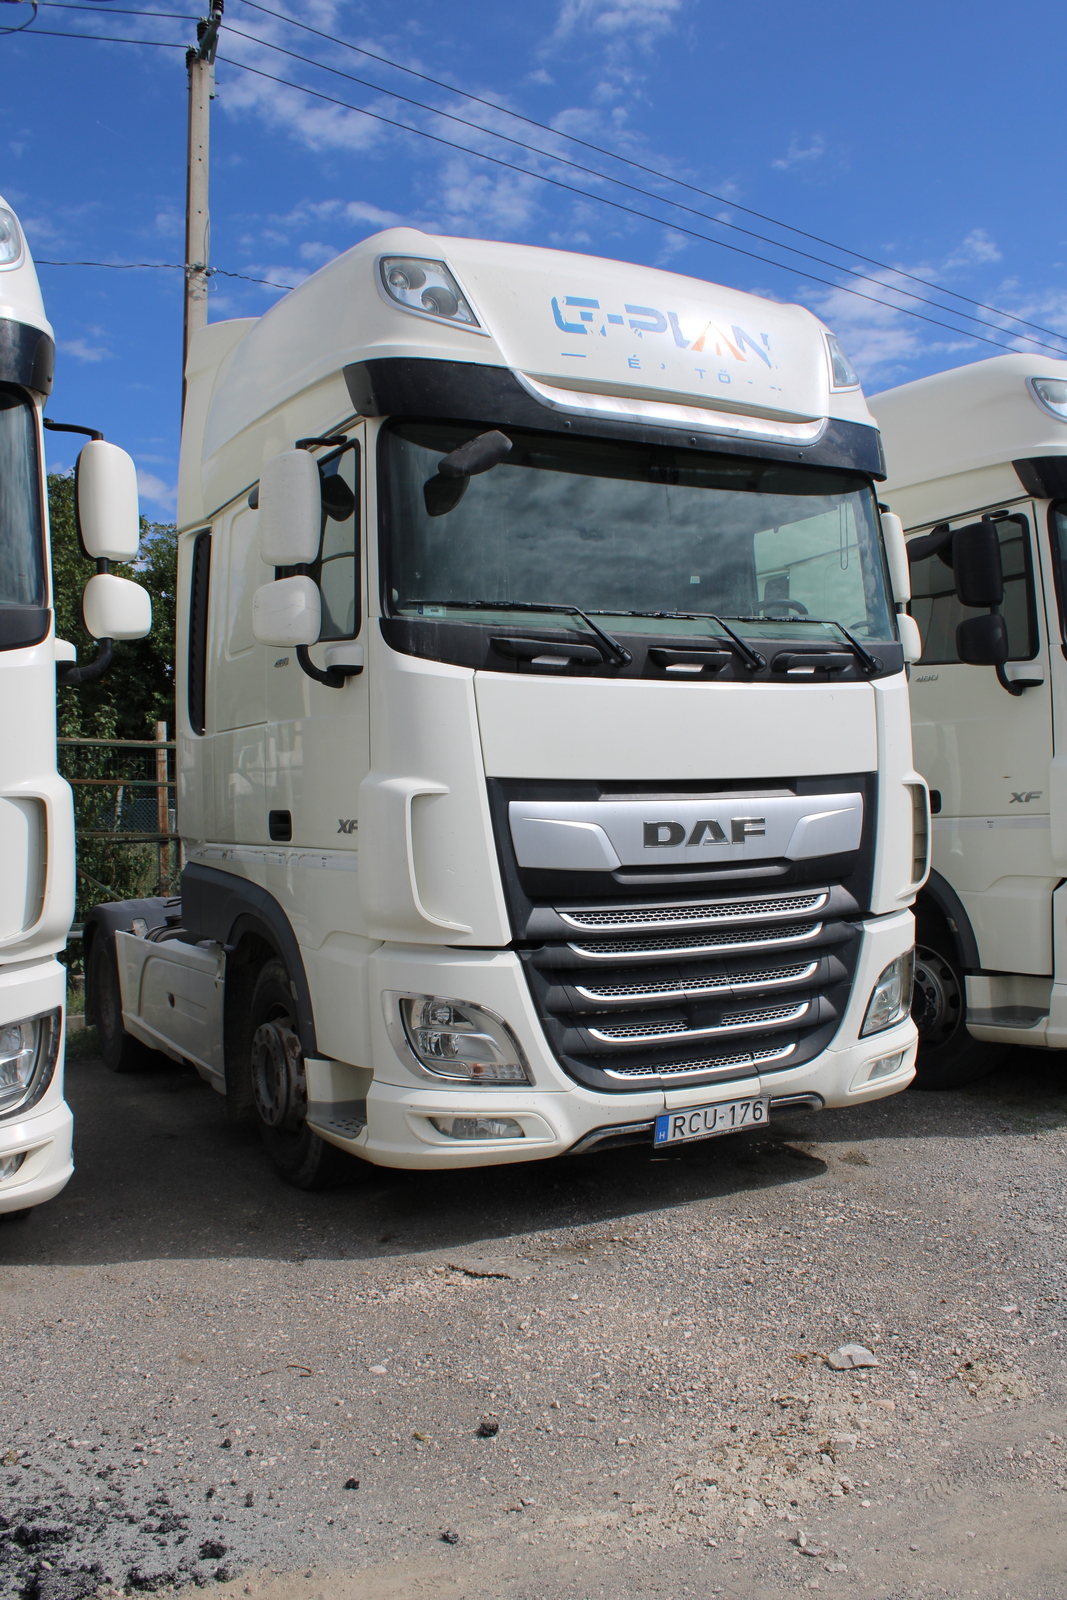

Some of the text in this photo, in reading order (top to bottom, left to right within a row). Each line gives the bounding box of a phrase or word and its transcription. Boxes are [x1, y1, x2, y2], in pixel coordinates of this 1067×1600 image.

[1009, 791, 1043, 804] XF
[337, 819, 358, 834] XF
[643, 817, 766, 848] DAF
[673, 1101, 763, 1138] RCU-176
[658, 1130, 667, 1140] H
